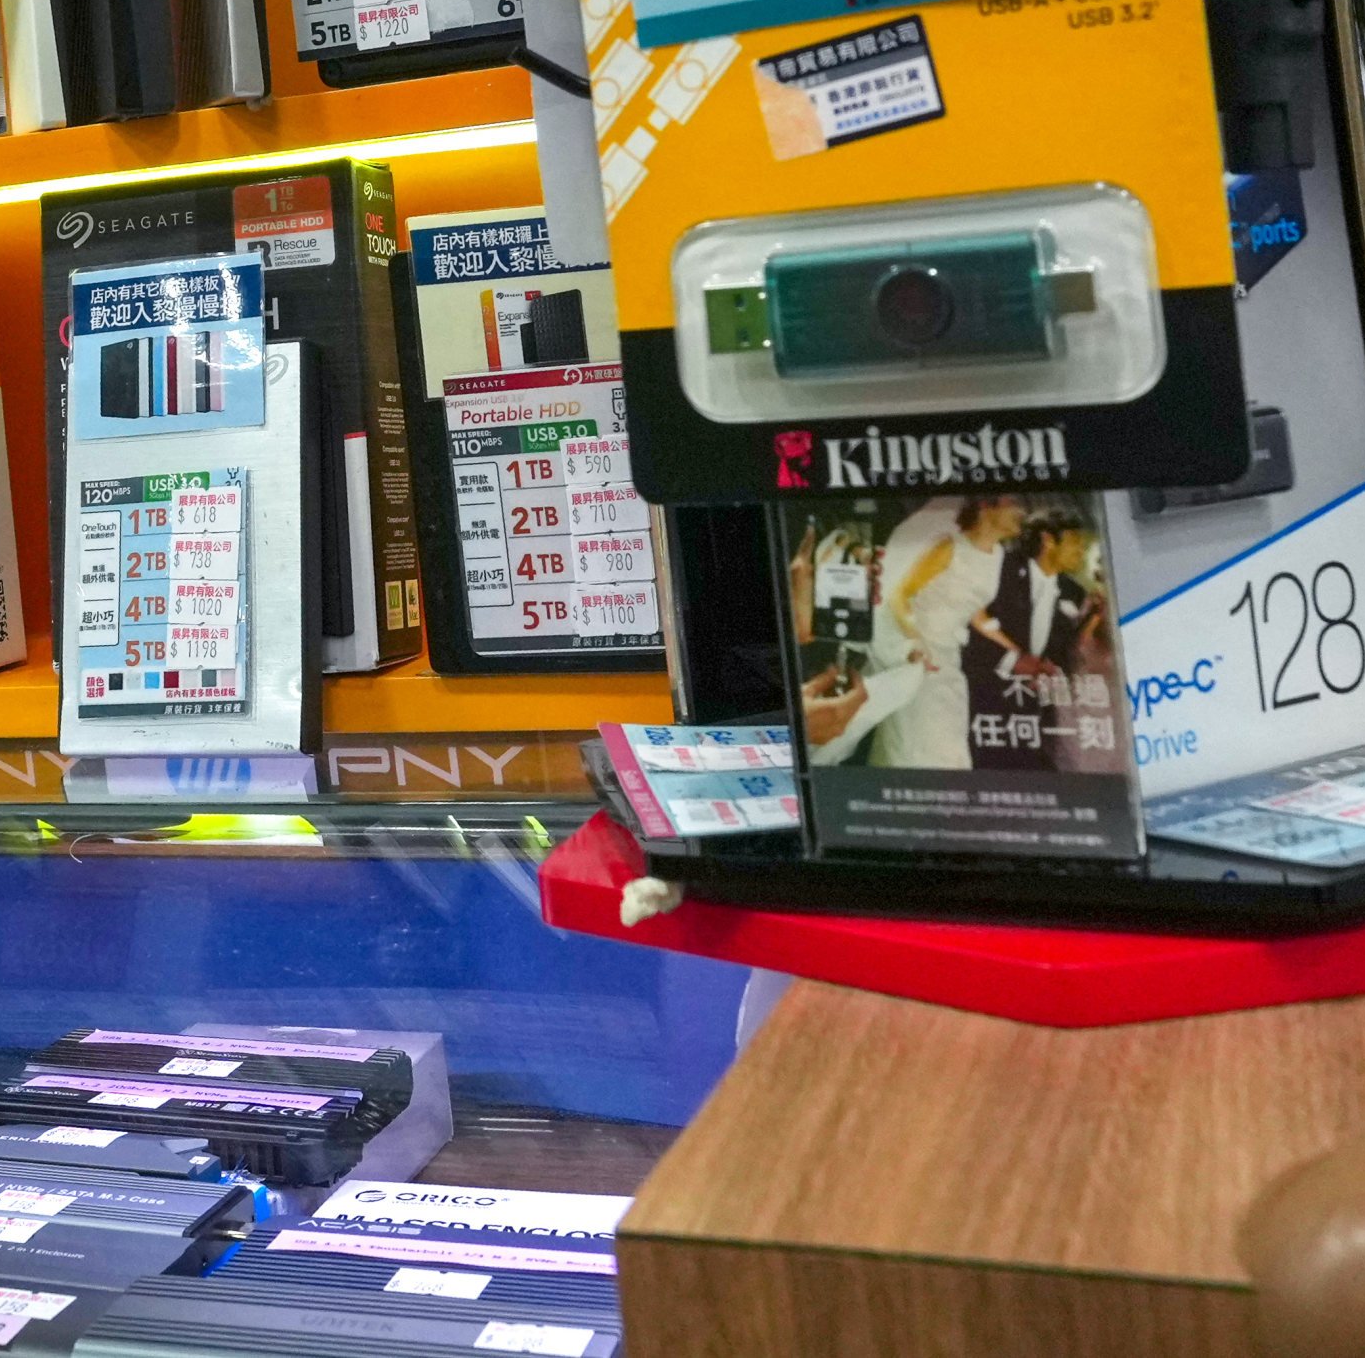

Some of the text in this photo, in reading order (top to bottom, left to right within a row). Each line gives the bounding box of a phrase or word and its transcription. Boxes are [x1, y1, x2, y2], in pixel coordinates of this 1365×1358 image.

[97, 209, 195, 234] SEAGATE
[273, 237, 318, 253] Rescue
[460, 401, 581, 425] Portable HDD
[822, 423, 1069, 491] Kingston
[178, 493, 236, 508] 展昇有限公司
[578, 537, 644, 553] 展昇有限公司
[1229, 558, 1365, 716] 128
[1000, 671, 1111, 708] 不錯過
[972, 712, 1116, 753] 任何一刻
[1133, 725, 1199, 766] Drive
[328, 745, 527, 790] PNY
[394, 1190, 497, 1210] ORICO
